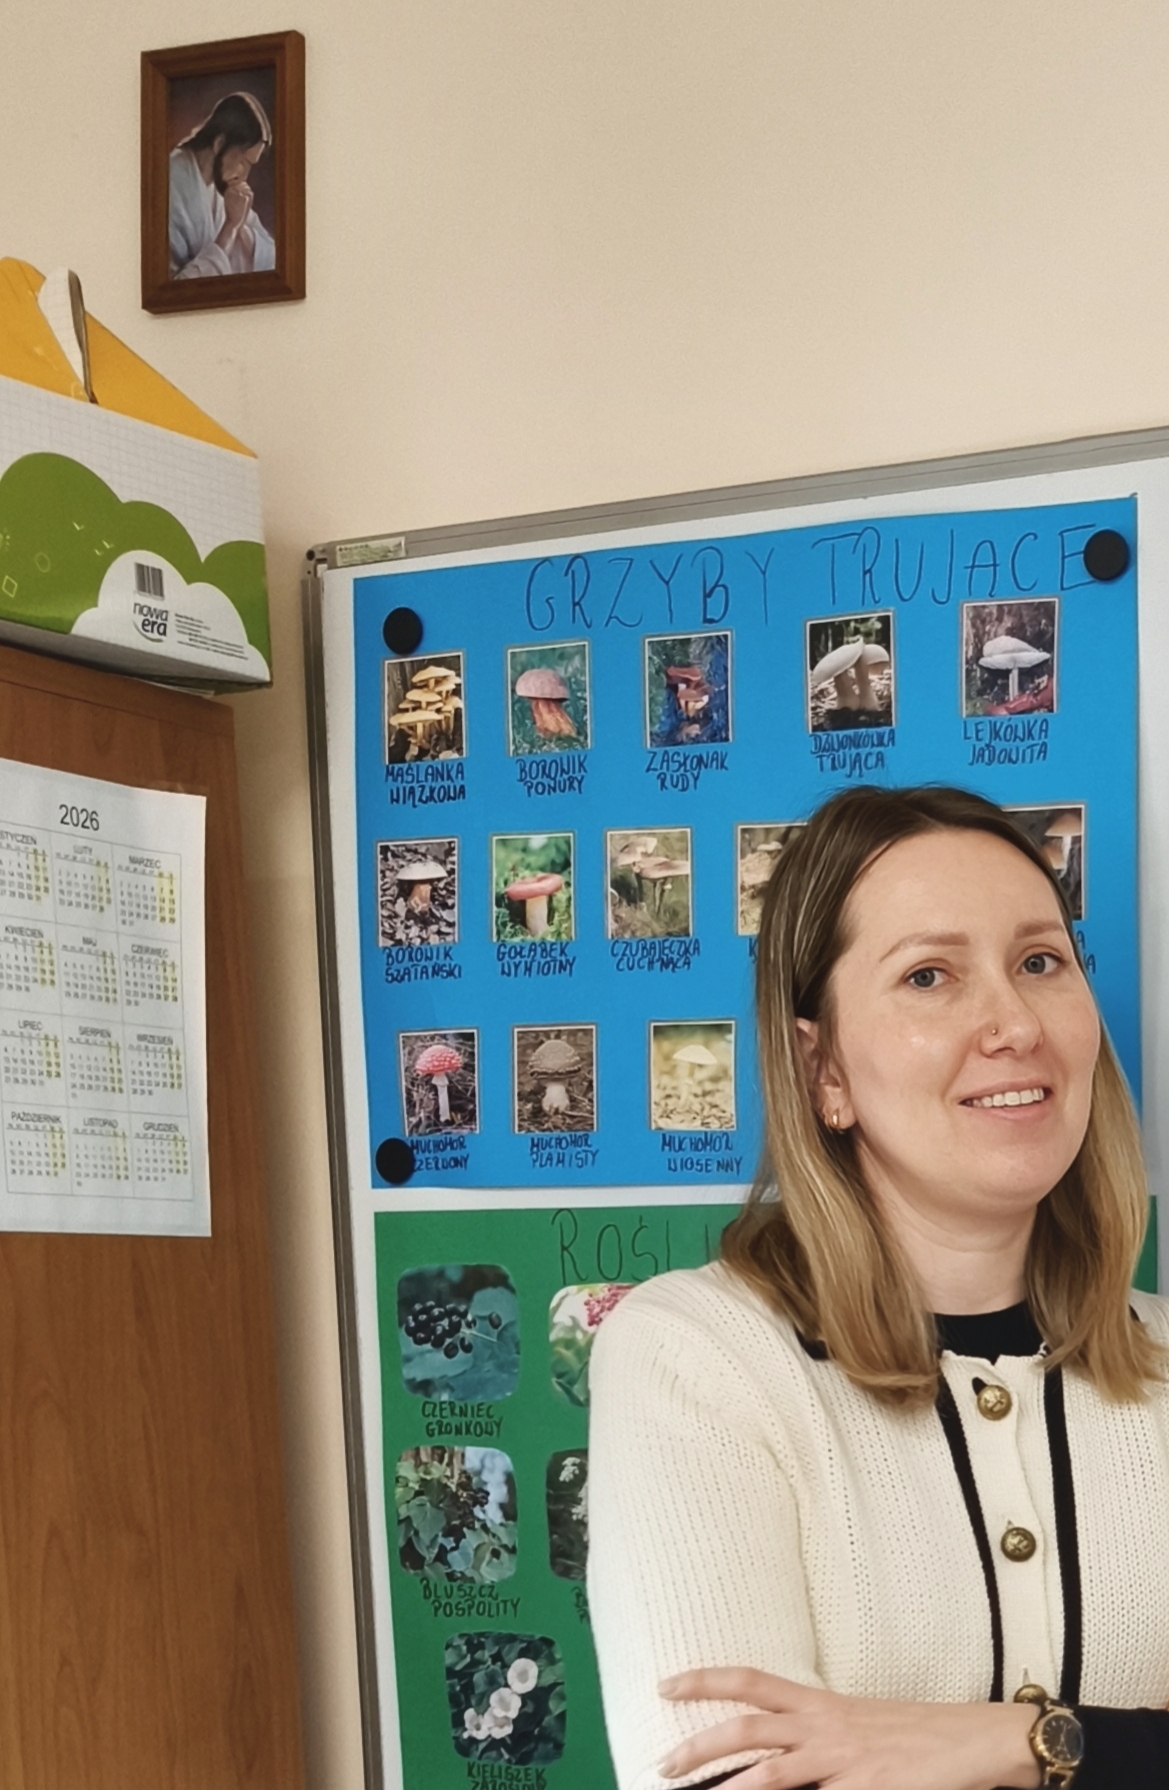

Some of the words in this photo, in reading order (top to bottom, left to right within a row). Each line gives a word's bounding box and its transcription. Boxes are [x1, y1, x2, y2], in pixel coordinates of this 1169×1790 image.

[525, 545, 775, 631] GRZYBY
[133, 602, 168, 622] nowa
[141, 618, 167, 637] era
[963, 717, 1049, 744] LEJKÓWKA
[645, 750, 729, 773] ZASŁONAK
[968, 741, 1048, 766] JADOWITA
[385, 762, 465, 784] MAŚLANKA
[515, 753, 588, 782] BOROWIK
[523, 775, 585, 797] PONURY
[657, 771, 700, 792] RUDY
[59, 804, 100, 831] 2026
[382, 945, 454, 967] BOROWIK
[501, 956, 576, 978] WYMIOTNY
[661, 1131, 734, 1153] MUCHOMOR
[414, 1153, 469, 1172] ZERWONY
[531, 1149, 599, 1169] PLAMISTY
[667, 1156, 743, 1176] WIOSENNY
[421, 1400, 494, 1419] CZERNIEC
[425, 1416, 503, 1438] GRONKOWY
[420, 1577, 499, 1600] BLUSZCZ
[431, 1598, 521, 1618] POSPOLITY
